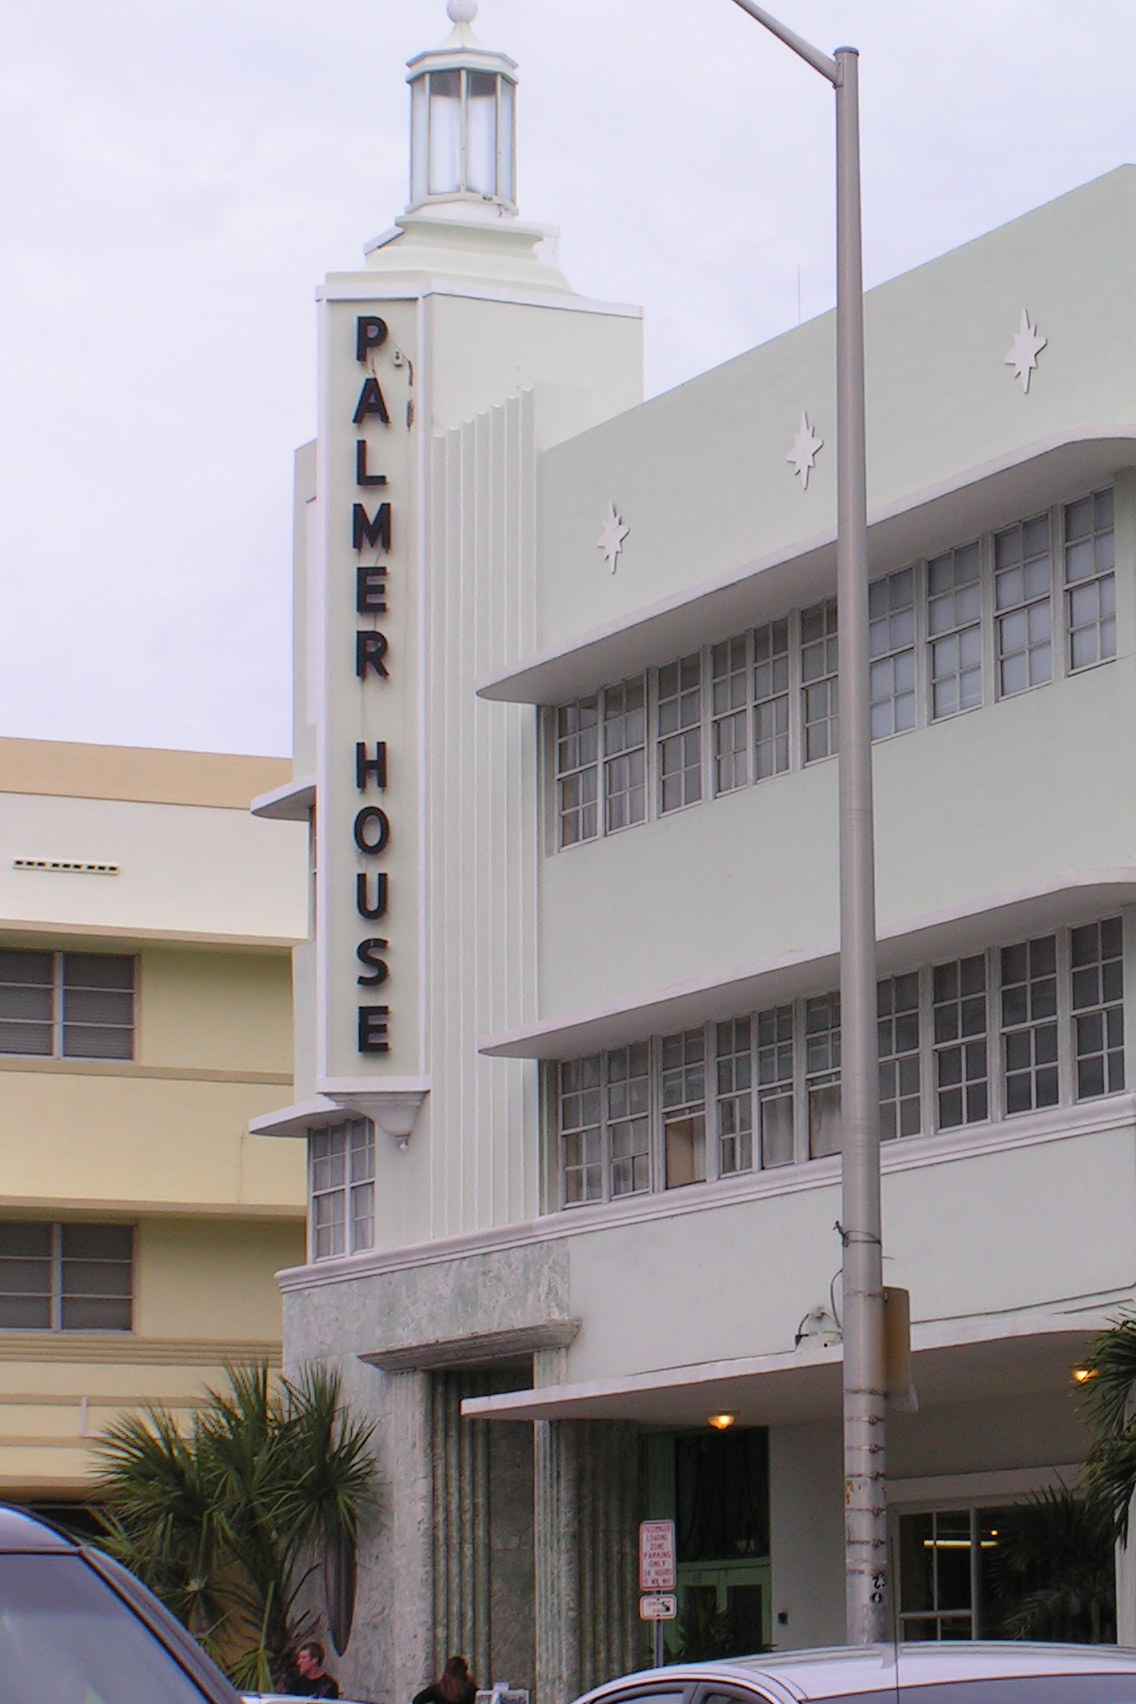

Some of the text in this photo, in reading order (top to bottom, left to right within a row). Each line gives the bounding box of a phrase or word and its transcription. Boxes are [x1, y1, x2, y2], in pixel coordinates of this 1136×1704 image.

[352, 315, 391, 1054] PALMER HOUSE
[644, 1551, 672, 1559] PARKING
[649, 1560, 666, 1568] ONLY
